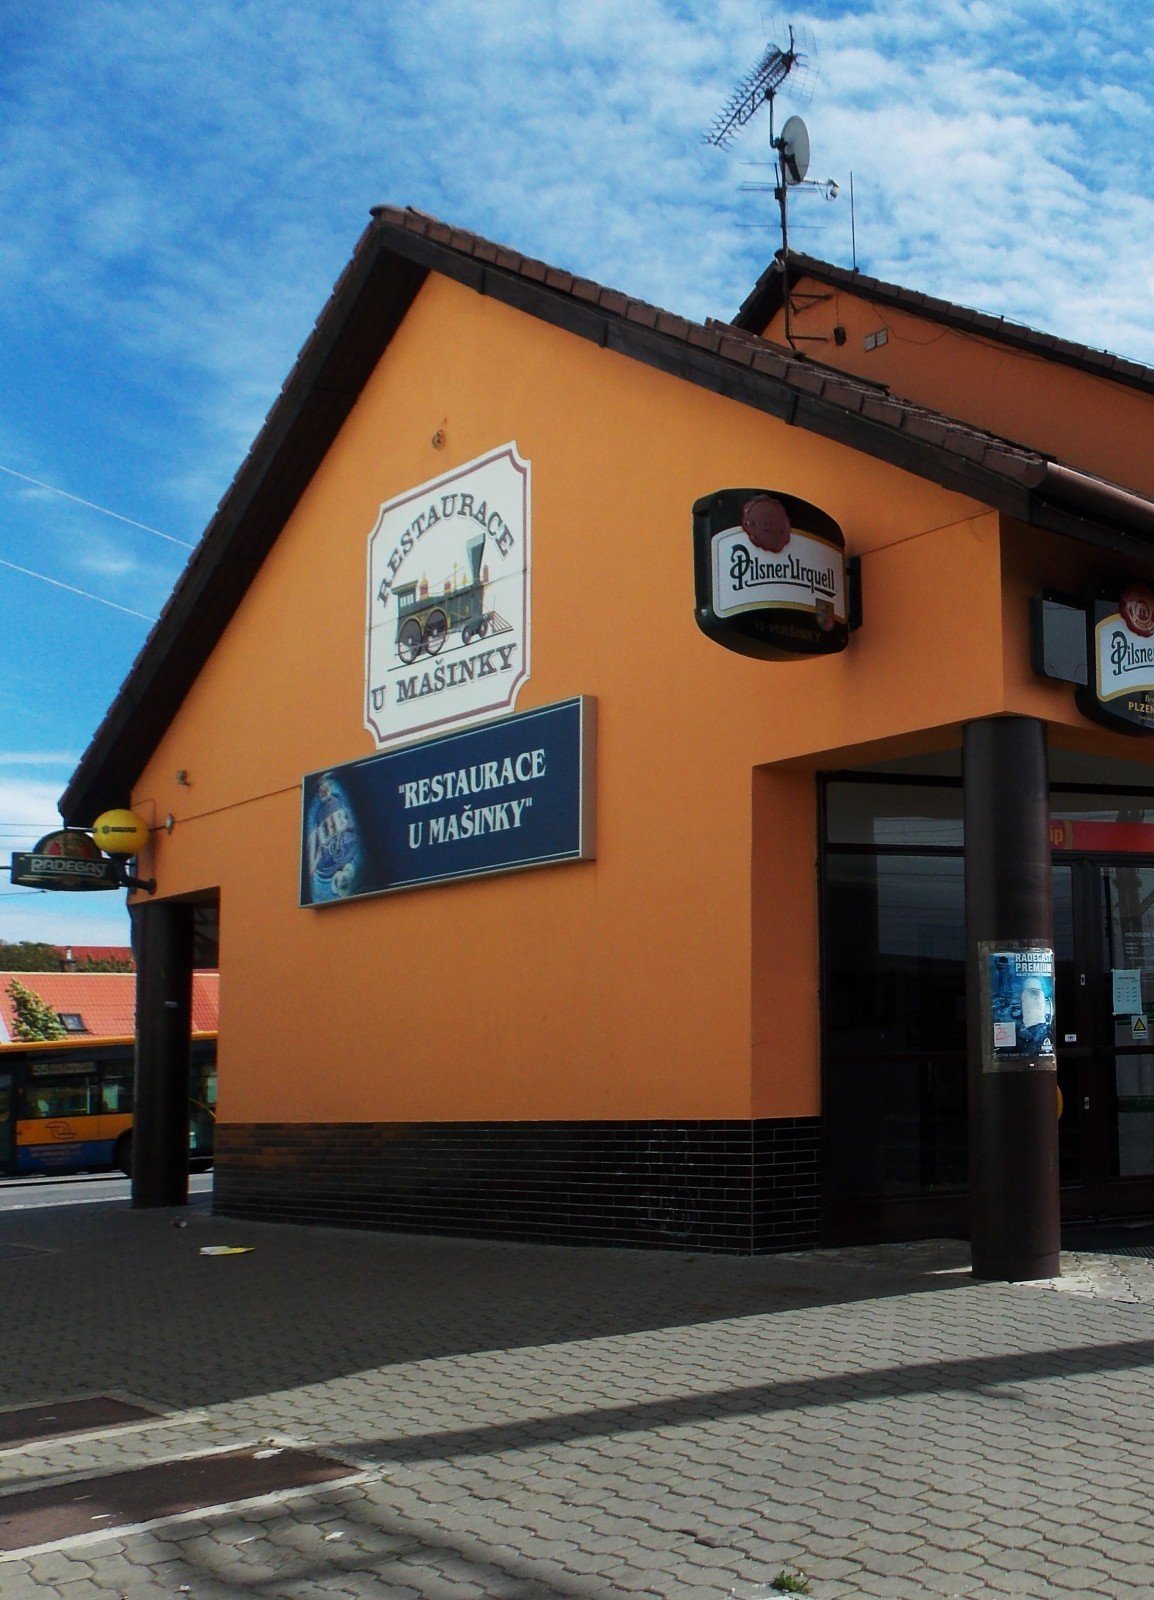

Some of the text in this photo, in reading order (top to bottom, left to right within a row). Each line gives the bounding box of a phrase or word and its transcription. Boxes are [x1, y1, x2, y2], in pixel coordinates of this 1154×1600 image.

[377, 492, 515, 608] RESTAURACE
[730, 544, 835, 593] Pilsner Urquell
[371, 643, 517, 711] U MAŠINKY
[398, 748, 546, 809] "RESTAURACE
[408, 797, 533, 850] U MAŠINKY"
[1049, 825, 1064, 844] ip
[30, 858, 108, 876] RADEGAST
[1015, 953, 1053, 963] RADEGAST
[1015, 963, 1052, 973] PREMIUM
